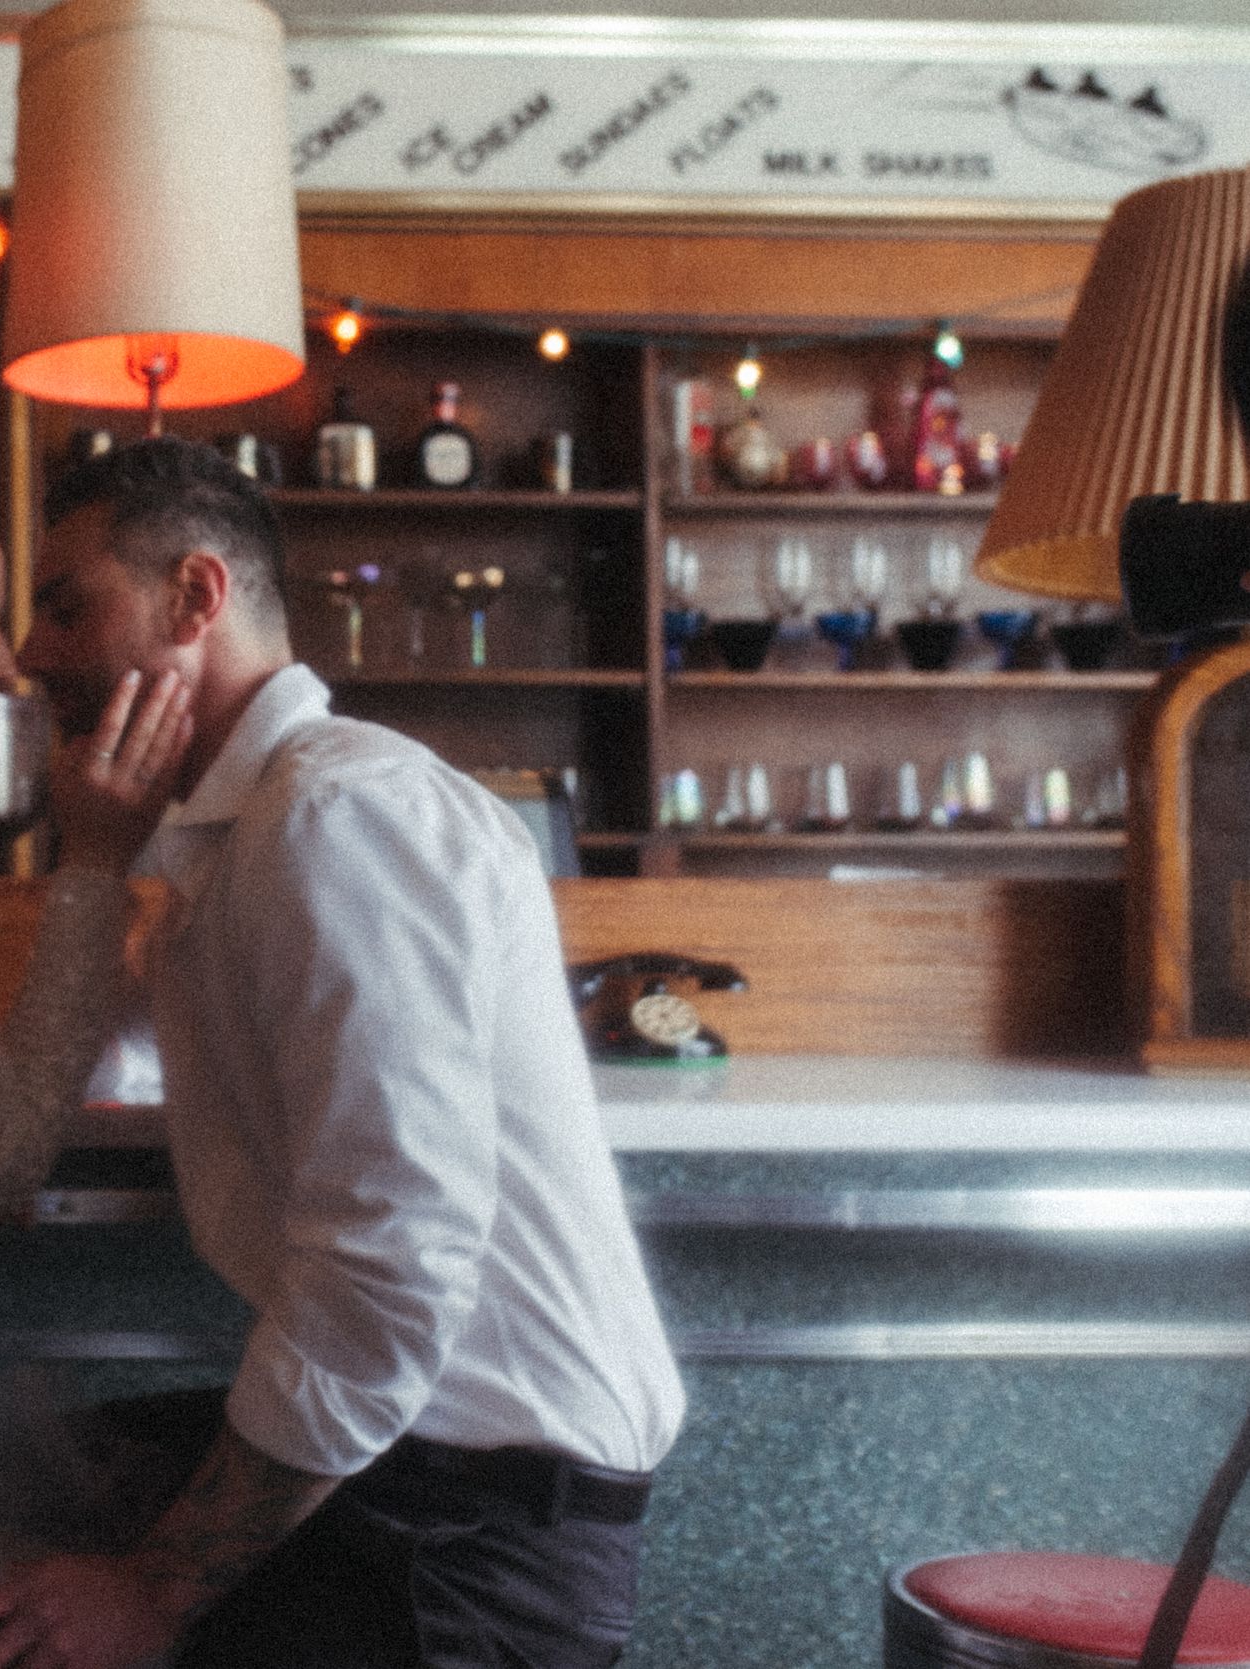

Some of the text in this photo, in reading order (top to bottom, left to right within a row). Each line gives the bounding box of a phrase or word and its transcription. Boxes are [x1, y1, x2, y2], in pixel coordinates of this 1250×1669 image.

[452, 92, 553, 174] CREAM
[559, 70, 690, 175] SUNDAES
[668, 87, 779, 173] FLOATS
[762, 150, 992, 178] MILK SHAKES
